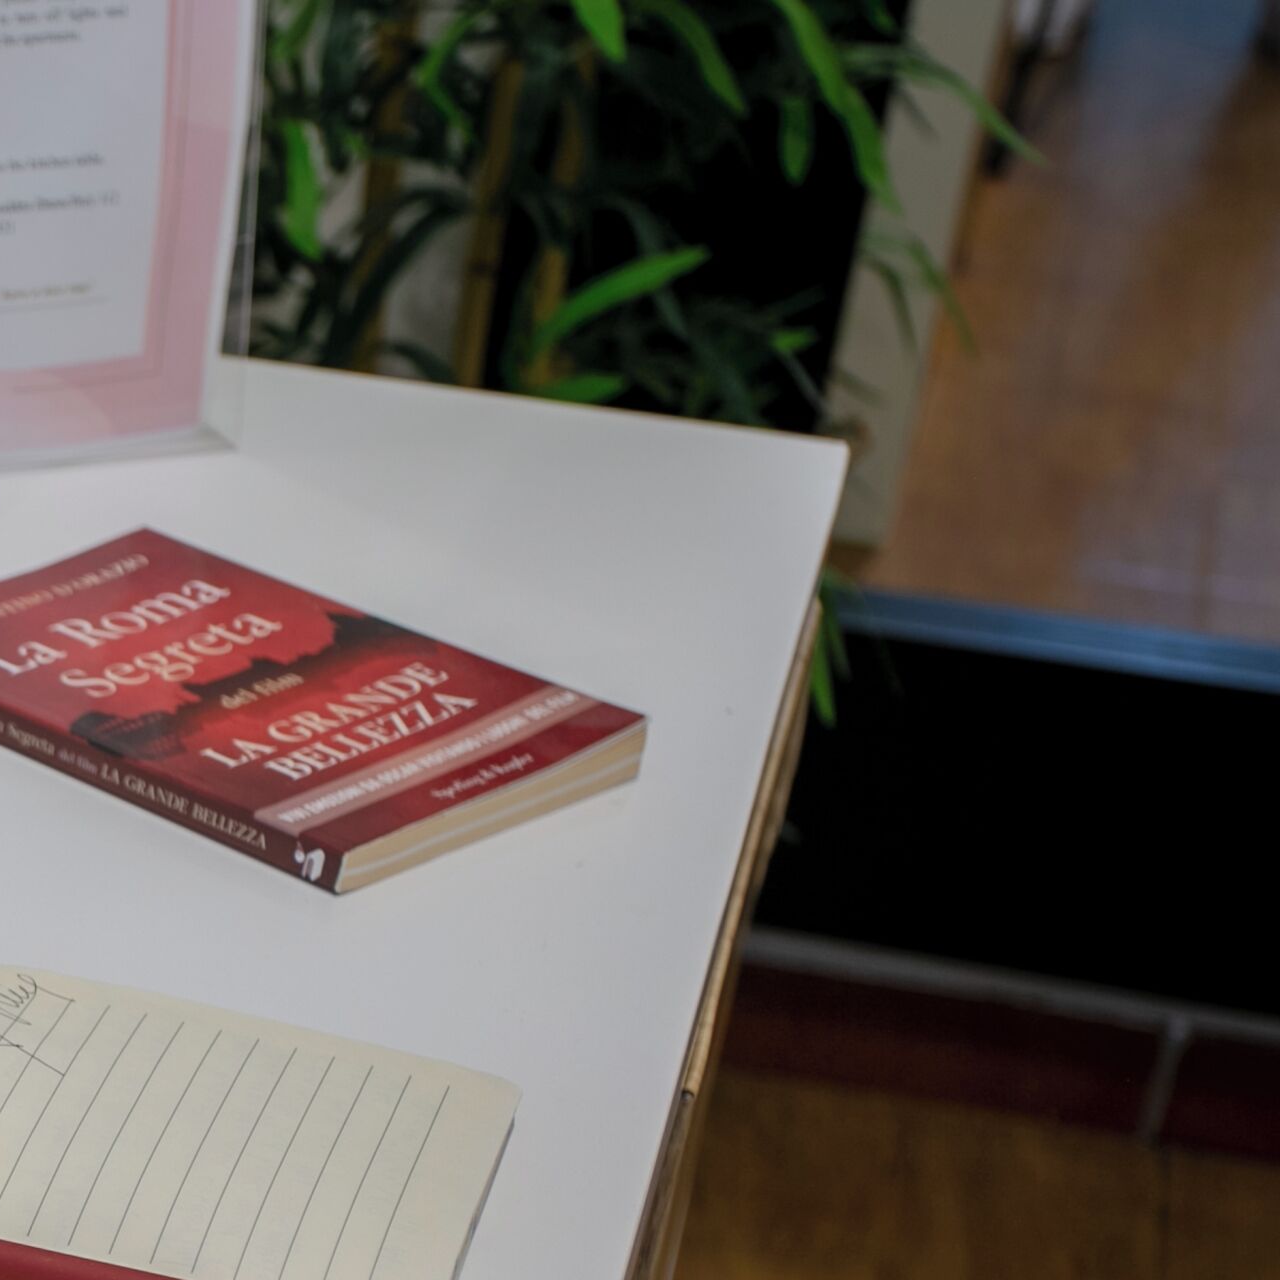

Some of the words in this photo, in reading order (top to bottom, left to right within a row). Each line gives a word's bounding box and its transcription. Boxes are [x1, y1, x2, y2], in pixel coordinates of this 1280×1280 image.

[47, 578, 232, 649] Roma
[58, 612, 283, 698] Segreta
[199, 736, 275, 769] LA
[266, 660, 451, 745] GRANDE
[219, 687, 258, 710] del
[252, 672, 305, 697] film
[263, 689, 478, 783] BELLEZZA
[7, 720, 56, 757] Segreta
[100, 762, 121, 787] LA
[122, 774, 190, 814] GRANDE
[191, 802, 268, 851] BELLEZZA
